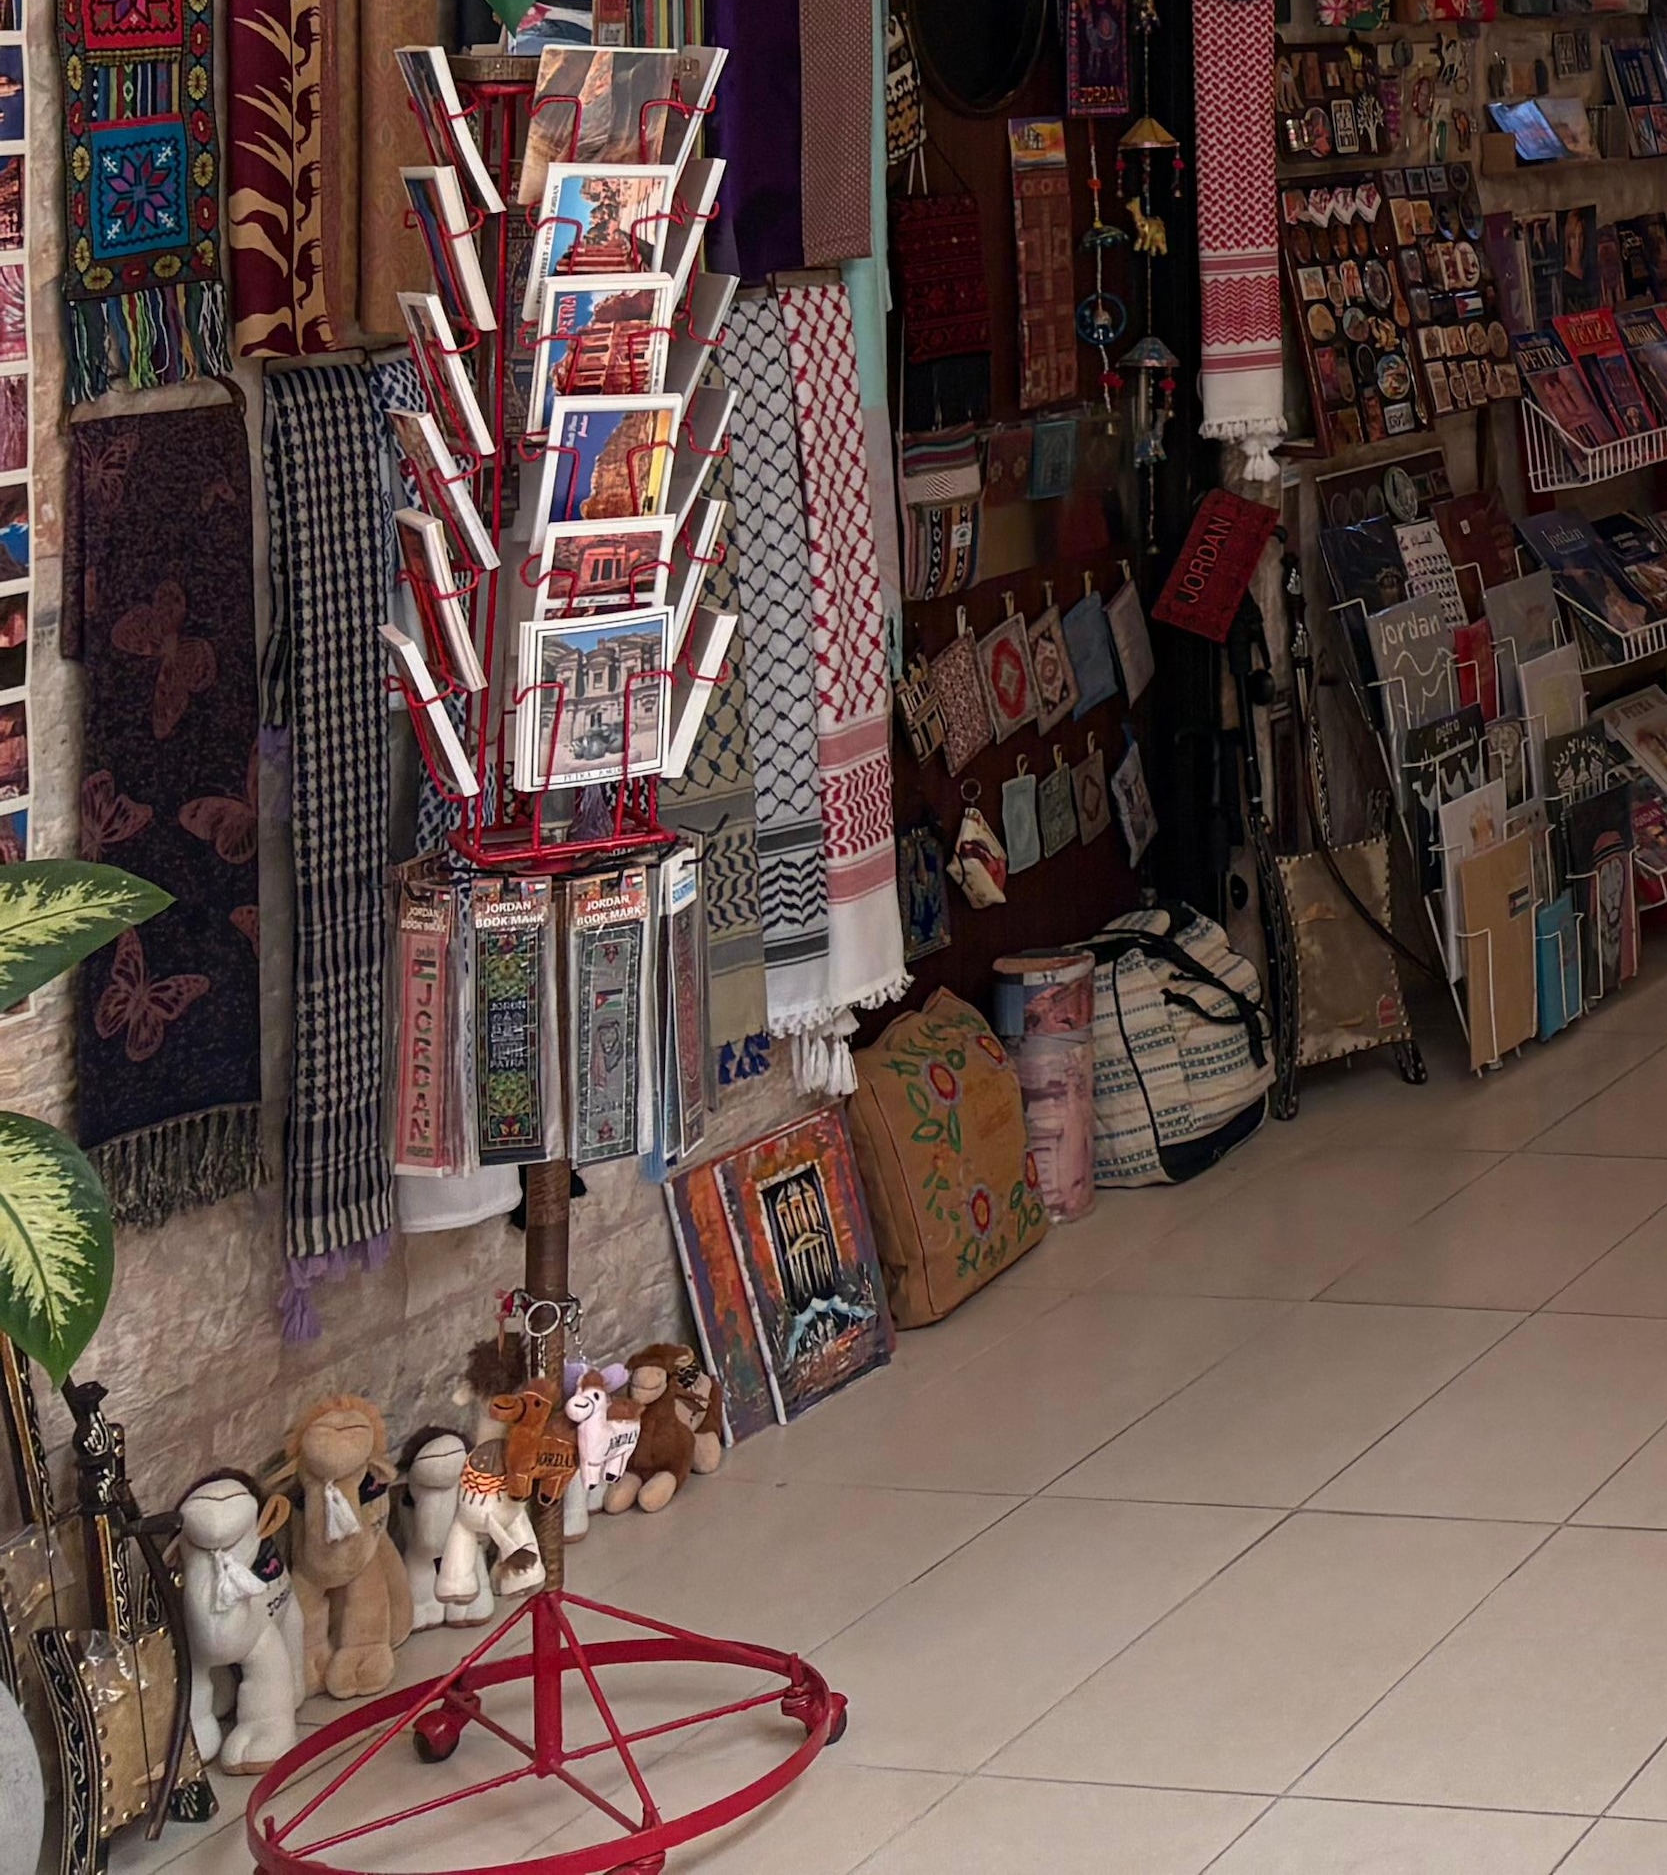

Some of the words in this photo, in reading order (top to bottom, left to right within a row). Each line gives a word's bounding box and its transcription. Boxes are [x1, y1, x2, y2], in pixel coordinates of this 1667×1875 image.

[1519, 345, 1567, 372] PETRA
[1541, 525, 1585, 552] Jordan
[1178, 517, 1233, 603] JORDAN
[1380, 611, 1440, 655] jordan
[408, 907, 440, 918] JORDAN
[485, 901, 532, 914] JORDAN
[586, 895, 630, 912] JORDAN
[475, 916, 508, 928] BOOK
[509, 913, 545, 925] MARK
[577, 912, 606, 926] BOOK
[609, 906, 642, 920] MARK
